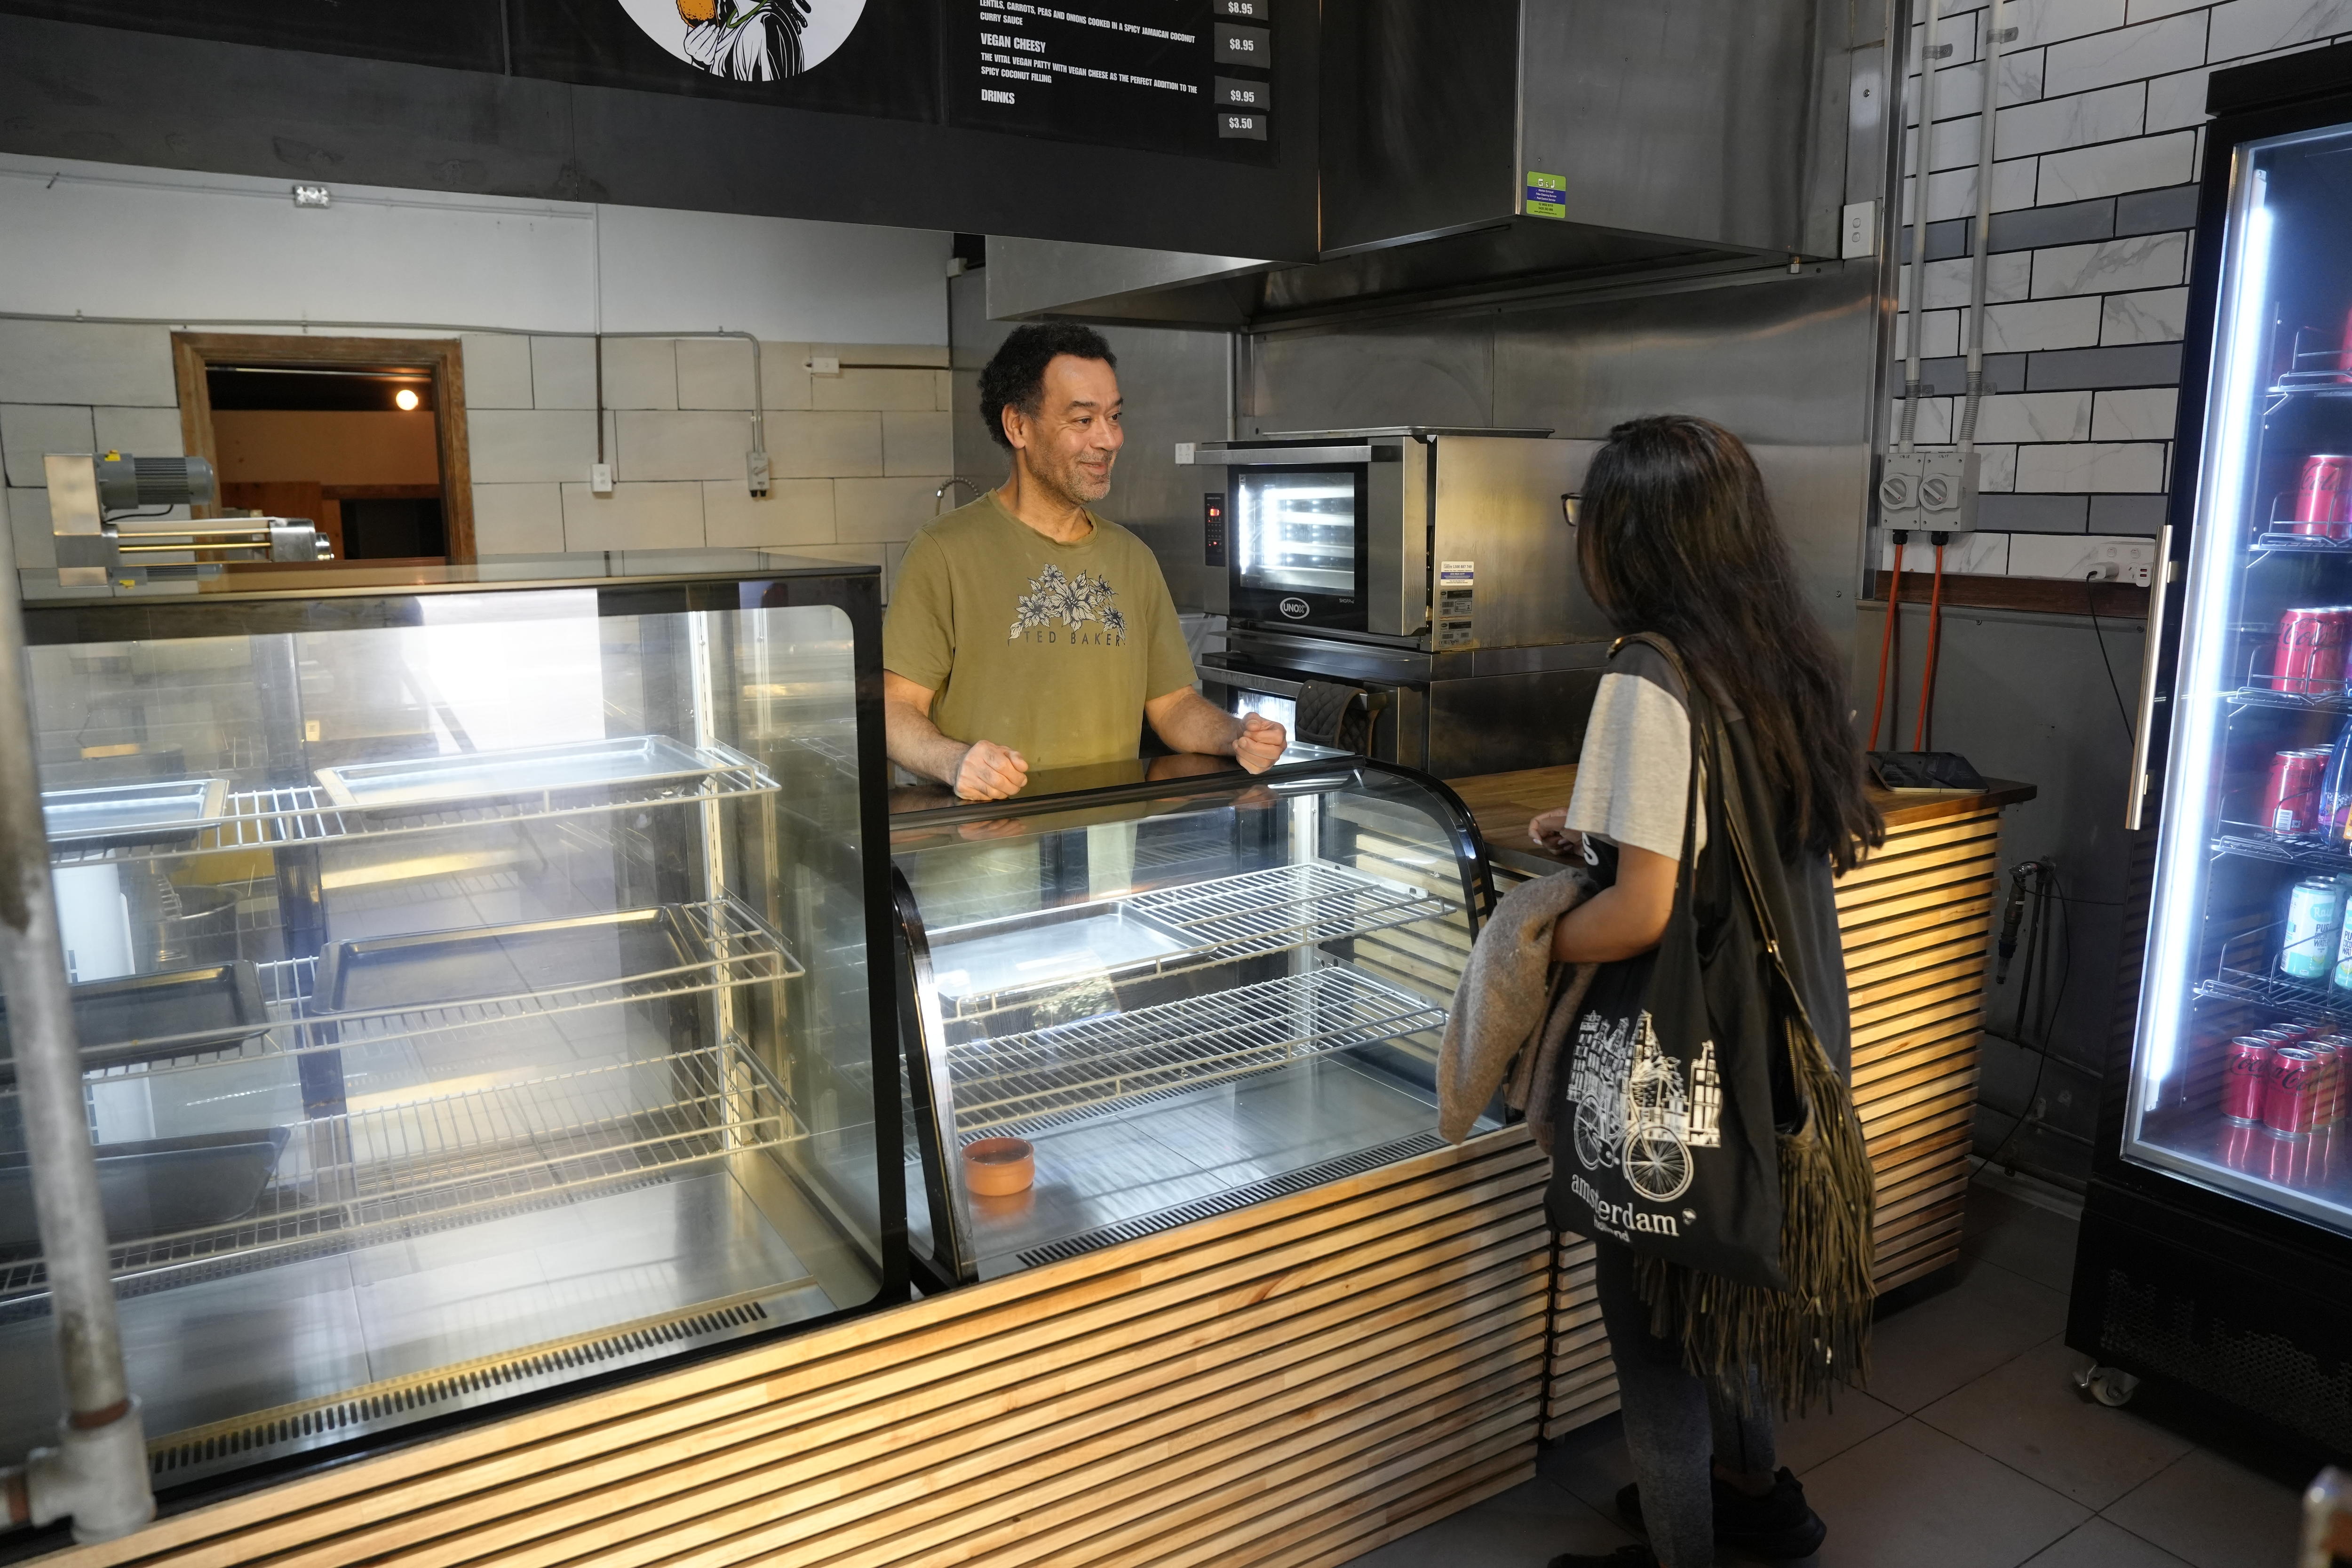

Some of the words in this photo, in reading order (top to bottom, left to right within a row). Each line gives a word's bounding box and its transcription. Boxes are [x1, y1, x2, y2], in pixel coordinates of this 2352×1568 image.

[1228, 1, 1253, 15] $8.95
[980, 12, 1001, 22] CURRY
[1003, 15, 1023, 25] SAUCE
[980, 0, 1005, 9] LENTILS,
[1007, 2, 1036, 15] CARROTS,
[1038, 7, 1051, 17] PEAS
[1053, 10, 1065, 19] AND
[1066, 13, 1086, 24] ONIONS
[1088, 17, 1110, 28] COOKED
[1124, 24, 1140, 33] SPICY
[1142, 27, 1168, 38] JAMAICAN
[1170, 32, 1195, 43] COCONUT
[981, 33, 1010, 48] VEGAN
[1014, 38, 1046, 53] CHEESY
[1230, 38, 1254, 51] $8.95
[981, 53, 993, 61] THE
[994, 54, 1010, 64] VITAL
[1012, 56, 1032, 66] VEGAN
[1034, 60, 1051, 69] PATTY
[1052, 63, 1067, 72] WITH
[1068, 66, 1086, 76] VEGAN
[1088, 69, 1108, 79] CHEESE
[1119, 74, 1129, 82] THE
[1130, 76, 1152, 86] PERFECT
[1154, 80, 1178, 90] ADDITION
[981, 66, 999, 76] SPICY
[1001, 69, 1030, 80] COCONUT
[1031, 73, 1051, 83] FILLING
[982, 89, 1015, 104] DRINKS
[1231, 90, 1255, 103] $9.95
[1229, 117, 1252, 129] $3.50
[1538, 178, 1543, 187] G
[1550, 180, 1555, 188] J
[1283, 603, 1304, 613] UNOX
[1024, 631, 1056, 643] TED
[1071, 632, 1120, 646] BAKER
[1221, 672, 1266, 690] BAKERLUX
[1571, 1174, 1680, 1237] amsterdam
